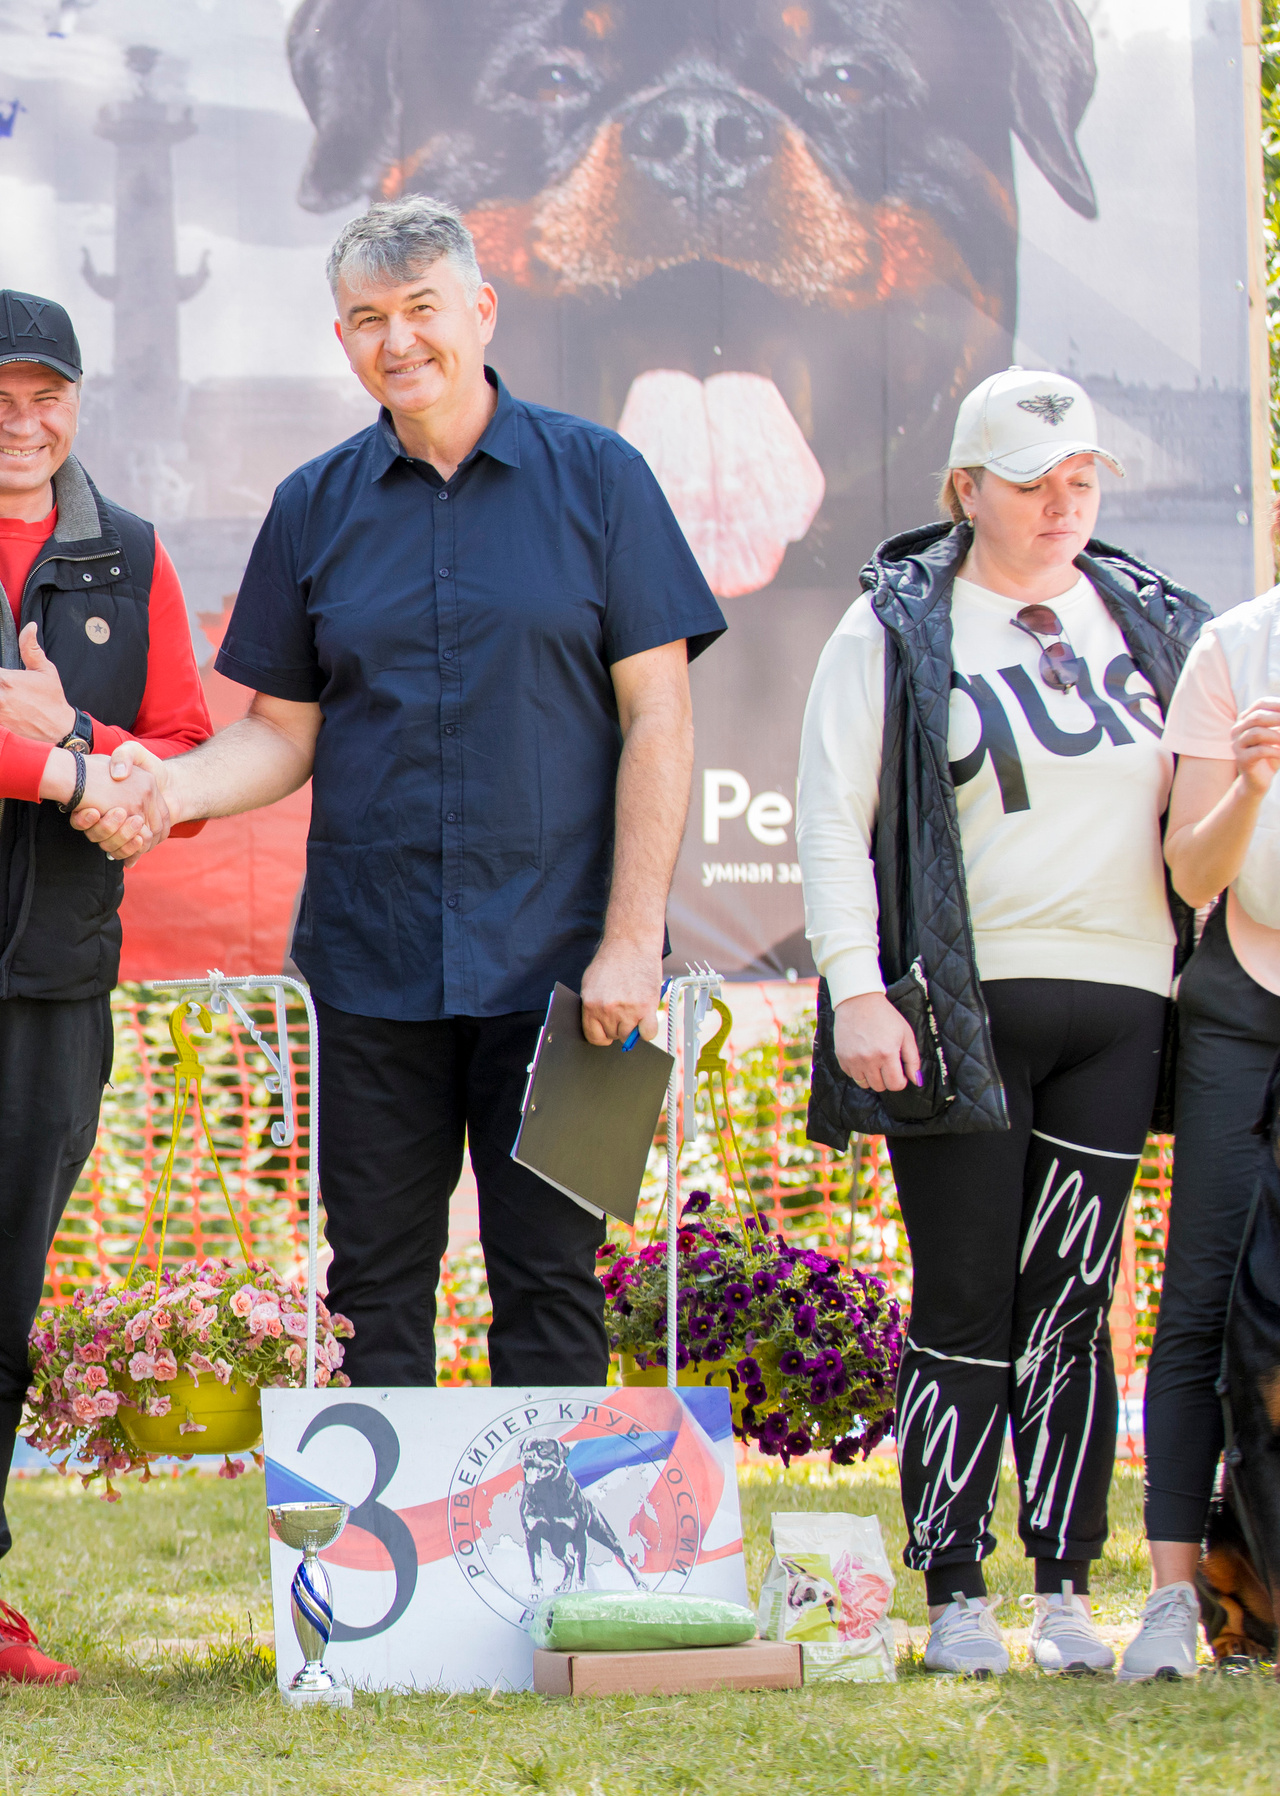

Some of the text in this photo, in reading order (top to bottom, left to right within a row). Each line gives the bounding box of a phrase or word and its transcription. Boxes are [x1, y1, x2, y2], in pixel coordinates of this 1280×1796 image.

[702, 768, 799, 846] Pe
[701, 861, 774, 888] умная
[297, 1402, 418, 1643] 3
[453, 1403, 697, 1579] РОТВЕЙЛЕР КЛУБ РОССИИ
